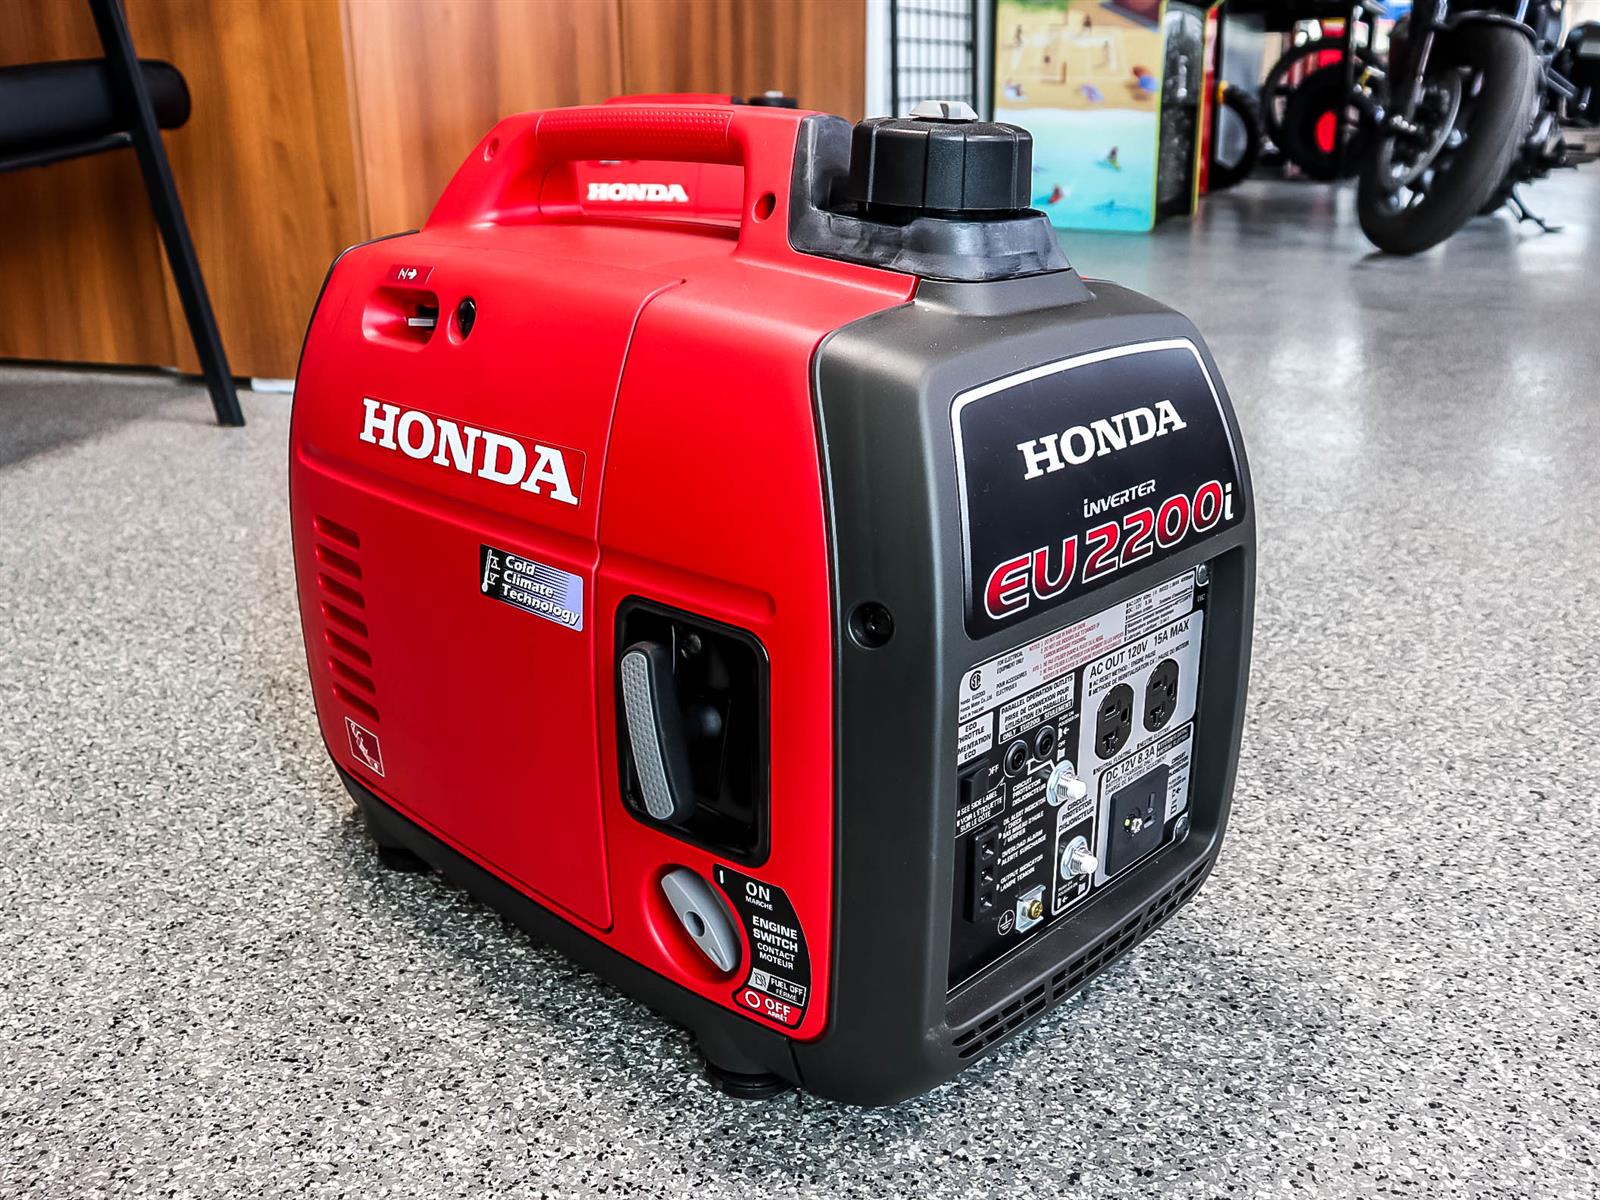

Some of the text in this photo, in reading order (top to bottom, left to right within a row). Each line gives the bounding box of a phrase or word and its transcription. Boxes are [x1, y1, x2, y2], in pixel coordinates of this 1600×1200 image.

[587, 183, 689, 203] HONDA
[1016, 399, 1187, 481] HONDA
[360, 397, 578, 506] HONDA
[984, 480, 1234, 620] EU2200i
[505, 554, 536, 577] Cold
[503, 570, 555, 598] Climate
[501, 583, 580, 625] Technology
[1089, 661, 1103, 679] AC
[1104, 650, 1126, 671] OUT
[1128, 639, 1148, 660] 120V
[1153, 629, 1168, 647] 15A
[1170, 619, 1189, 639] MAX
[1001, 675, 1073, 714] PARALLEL OPERATION OUTLETS
[1004, 710, 1019, 722] PRISE
[1020, 707, 1026, 715] DE
[1056, 686, 1069, 698] POUR
[965, 722, 977, 732] ECO
[1005, 711, 1034, 730] UTILISATION
[1002, 726, 1017, 739] ONLY
[964, 750, 976, 760] ECO
[1106, 746, 1155, 783] DC 12V 8.3A
[1013, 777, 1033, 791] CIRCUIT
[1013, 779, 1042, 798] PROTECTOR
[960, 790, 997, 815] SEE SIDE LABEL
[1062, 799, 1092, 821] PROTECTOR
[1067, 795, 1088, 811] CIRCUIT
[960, 813, 972, 825] VOIR
[960, 821, 971, 833] SUR
[971, 818, 977, 827] LE
[1010, 809, 1024, 822] ALERT
[1059, 806, 1094, 831] DISJONCTEUR
[1001, 829, 1043, 858] OVERLOAD ALARM
[1001, 834, 1046, 867] ALERTE SURCHARGE
[1000, 868, 1018, 884] OUTPUT
[745, 881, 770, 902] ON
[745, 895, 773, 911] MARCHE
[752, 915, 798, 940] ENGINE
[753, 928, 798, 953] SWITCH
[757, 942, 795, 962] CONTACT
[759, 951, 794, 970] MOTEUR
[771, 978, 803, 996] FUEL OFF
[765, 998, 791, 1016] OFF
